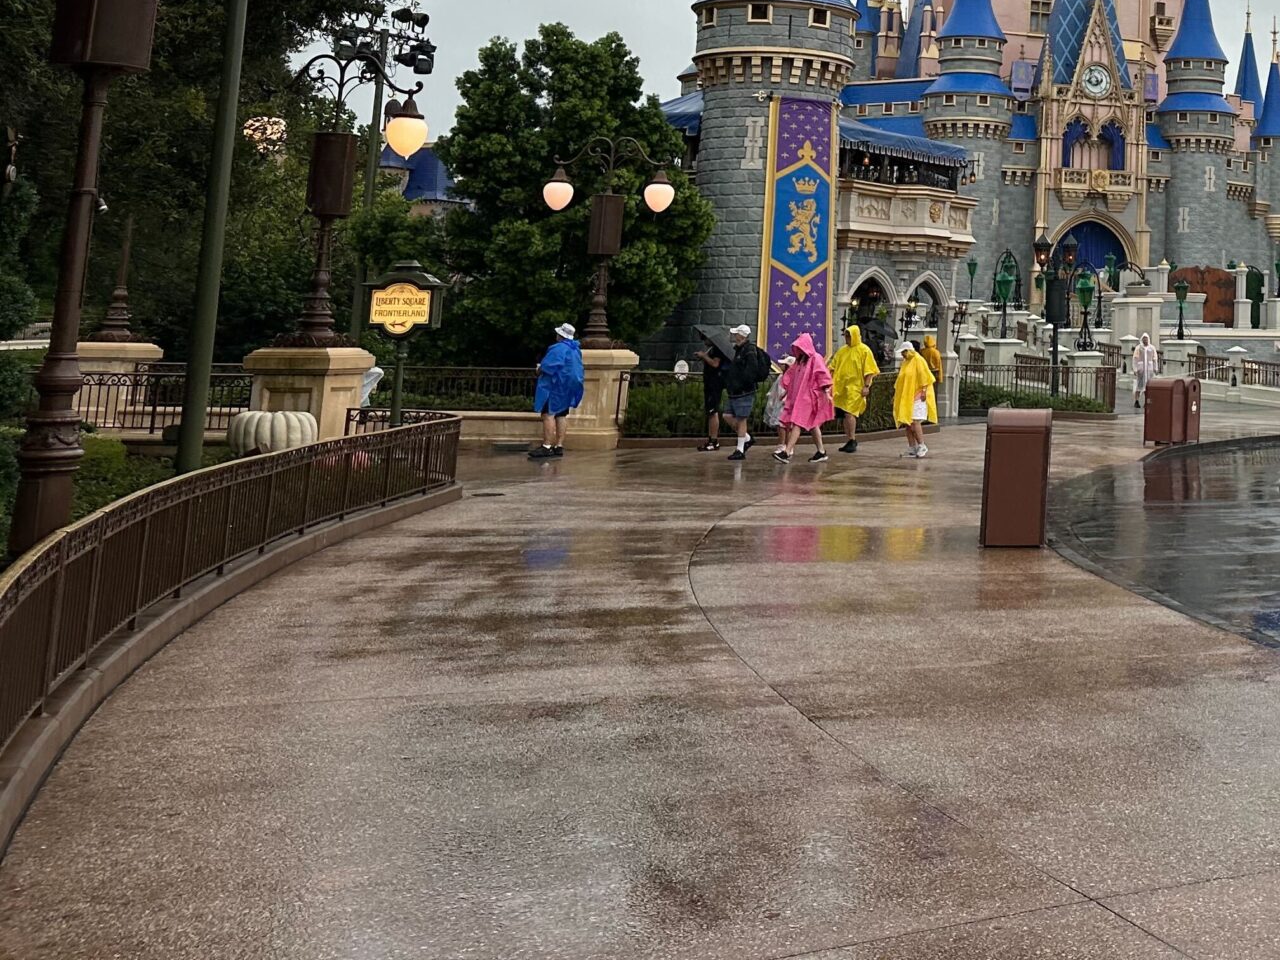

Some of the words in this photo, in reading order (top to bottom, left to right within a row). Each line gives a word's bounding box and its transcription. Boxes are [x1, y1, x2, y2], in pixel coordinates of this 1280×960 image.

[375, 297, 400, 306] LIBERTY
[402, 297, 426, 306] SQUARE
[374, 309, 426, 317] FRONTIERLAND
